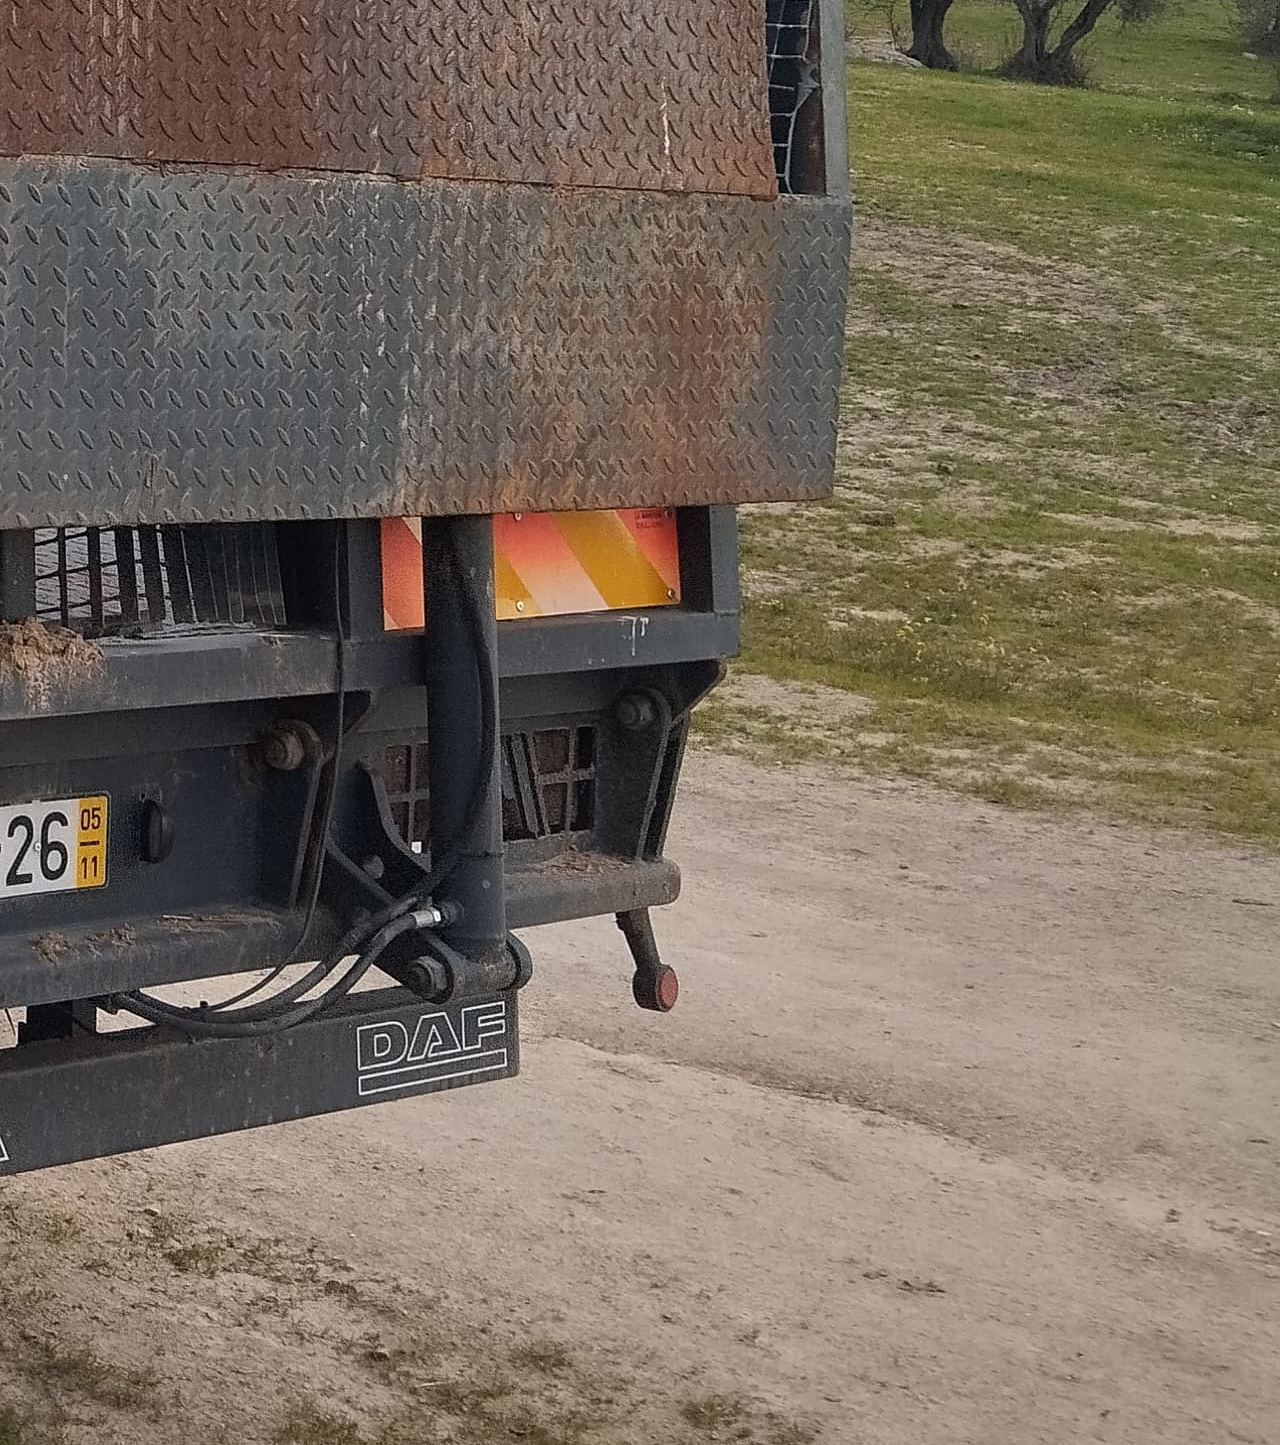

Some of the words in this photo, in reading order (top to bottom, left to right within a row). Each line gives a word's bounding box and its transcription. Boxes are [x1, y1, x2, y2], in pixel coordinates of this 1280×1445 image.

[81, 807, 102, 831] 05
[81, 855, 98, 879] 11
[356, 1001, 506, 1071] DAF
